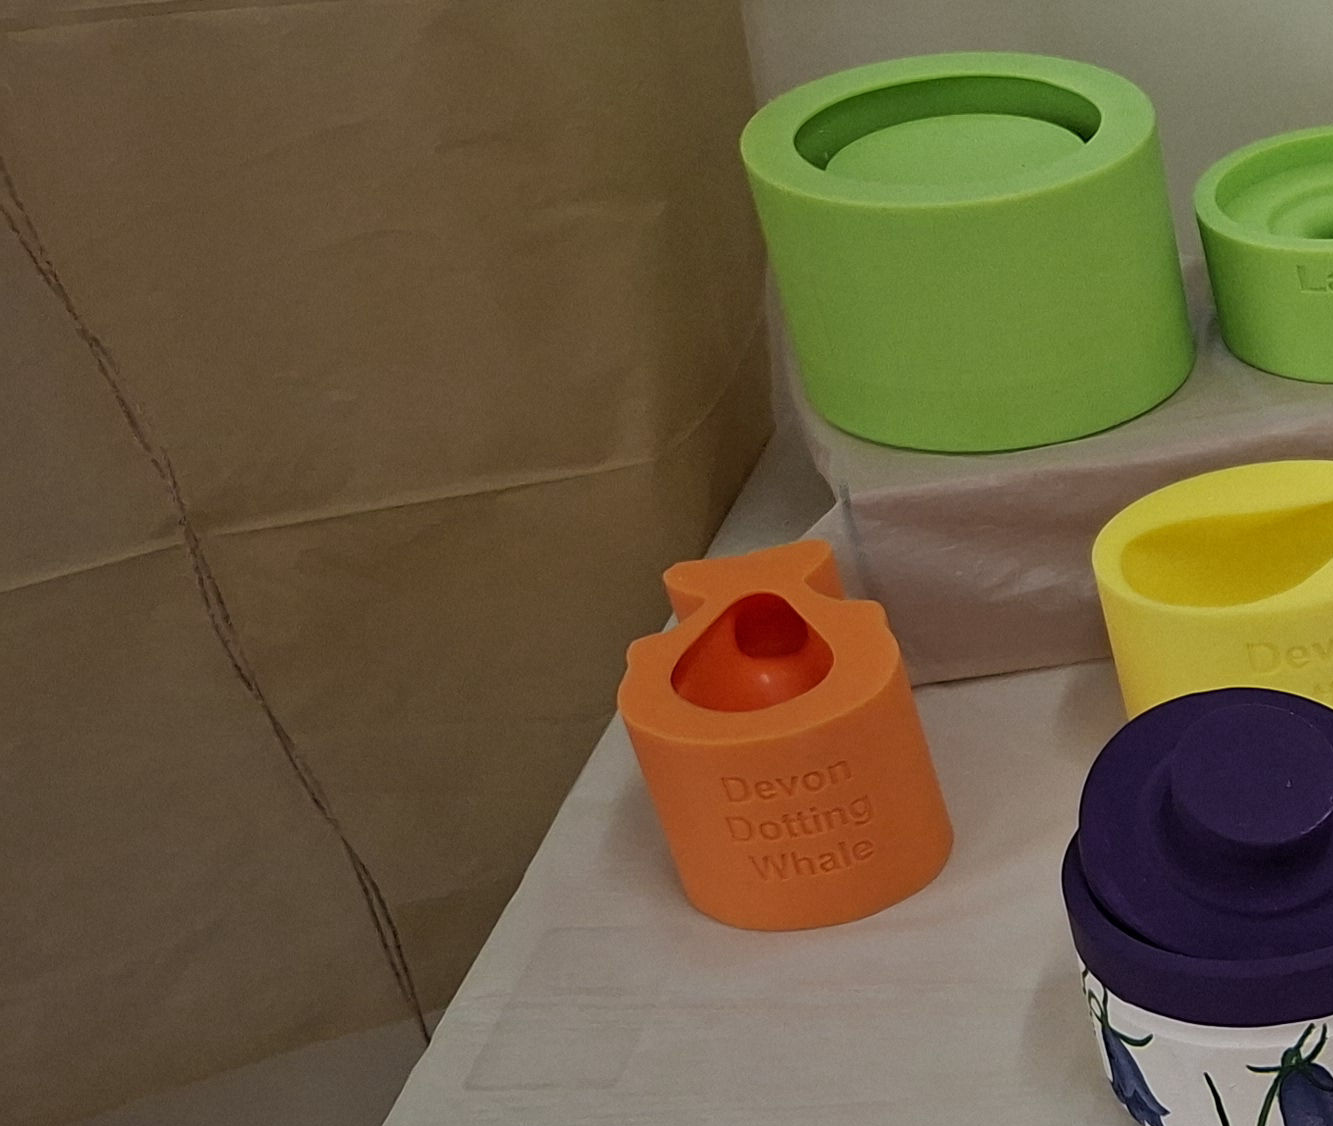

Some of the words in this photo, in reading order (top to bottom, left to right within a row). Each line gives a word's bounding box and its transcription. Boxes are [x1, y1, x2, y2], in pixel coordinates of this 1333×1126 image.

[721, 760, 852, 802] Devon
[725, 795, 874, 842] Dotting
[749, 839, 875, 882] Whale
